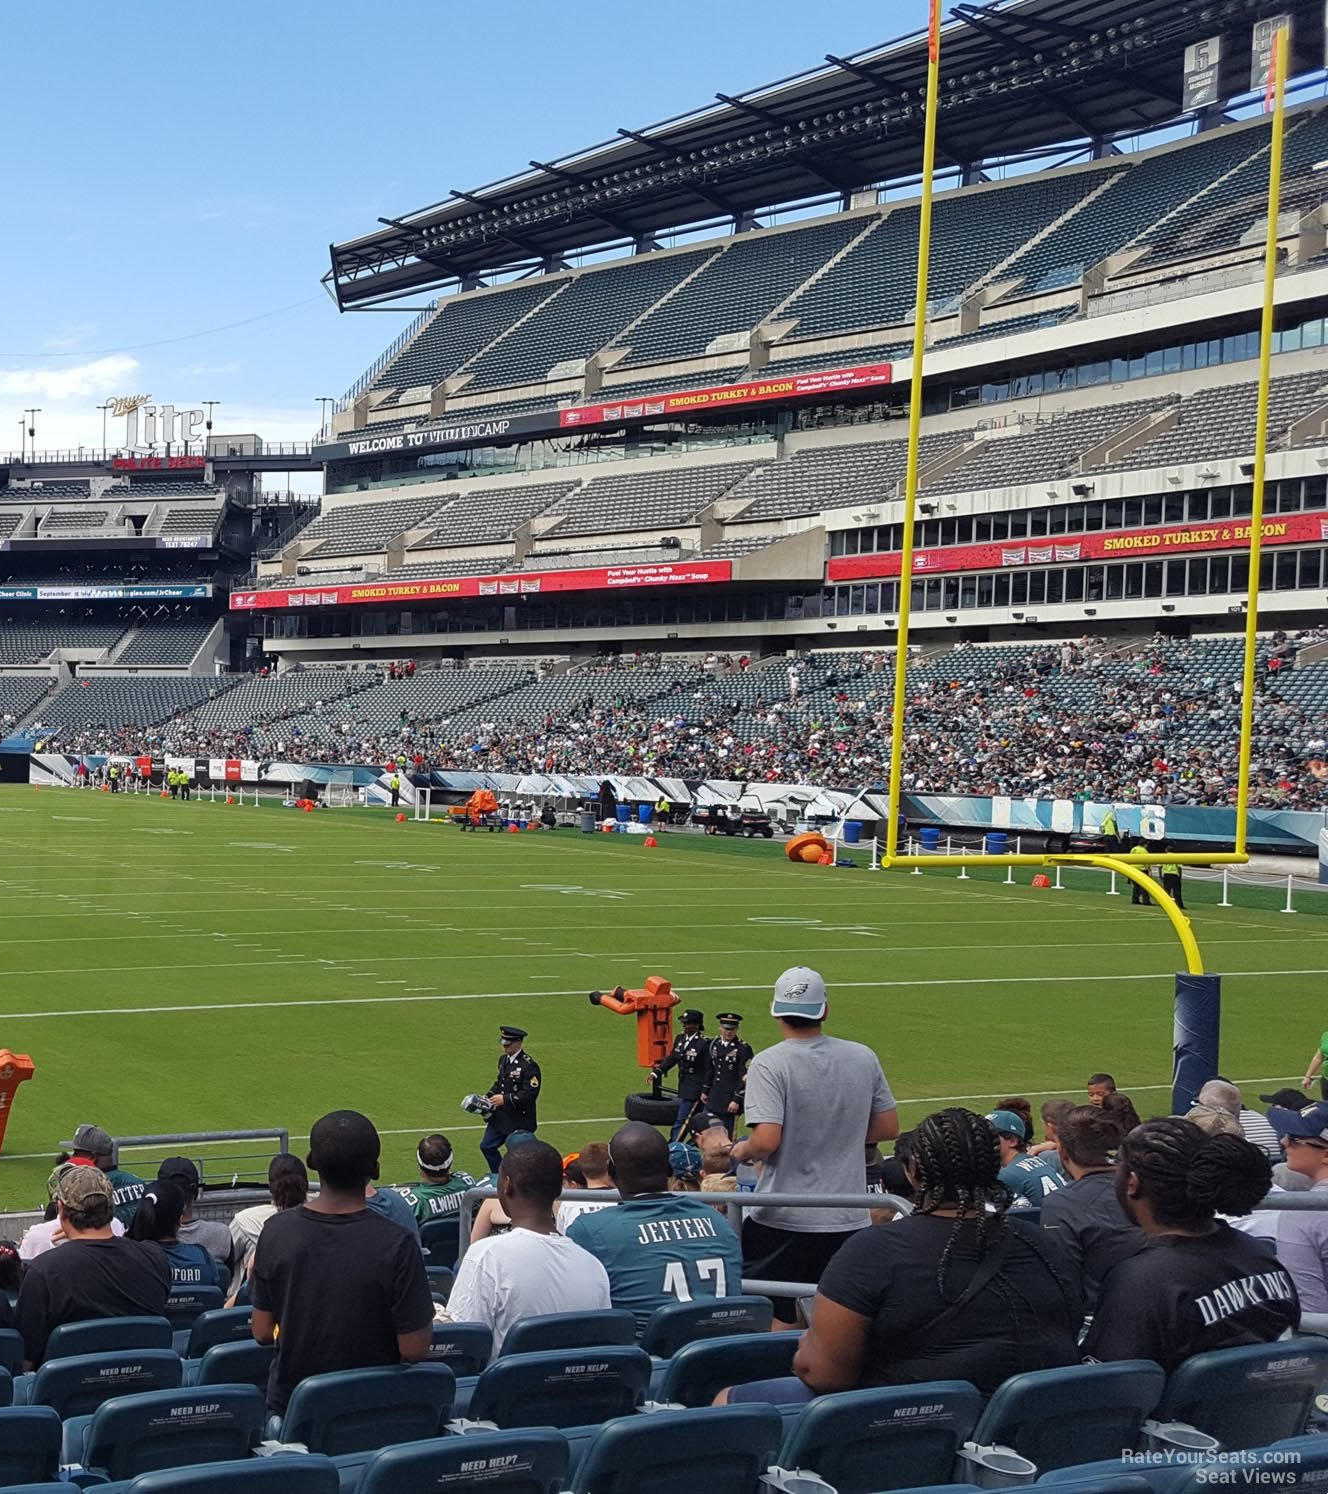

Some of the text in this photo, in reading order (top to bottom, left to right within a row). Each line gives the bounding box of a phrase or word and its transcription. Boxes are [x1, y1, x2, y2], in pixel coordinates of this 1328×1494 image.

[1194, 42, 1210, 71] 5
[669, 382, 793, 408] SMOKED TURKEY & BACON
[122, 405, 205, 456] Lite
[349, 436, 403, 455] WELCOME
[408, 434, 423, 447] TO
[1104, 535, 1160, 551] SMOKED
[1162, 529, 1219, 545] TURKEY
[1221, 528, 1232, 540] &
[351, 588, 386, 598] SMOKED
[387, 585, 421, 595] TURKEY
[429, 583, 460, 593] BACON
[638, 1217, 718, 1245] JEFFERY
[172, 1268, 201, 1281] FORD
[1195, 1270, 1291, 1327] DAWKINS
[100, 1365, 142, 1376] NEED HELP?
[565, 1364, 609, 1374] NEED HELP?
[170, 1404, 220, 1417] NEED HELP?
[893, 1404, 944, 1418] NEED HELP?
[460, 1454, 519, 1473] NEED HELP?
